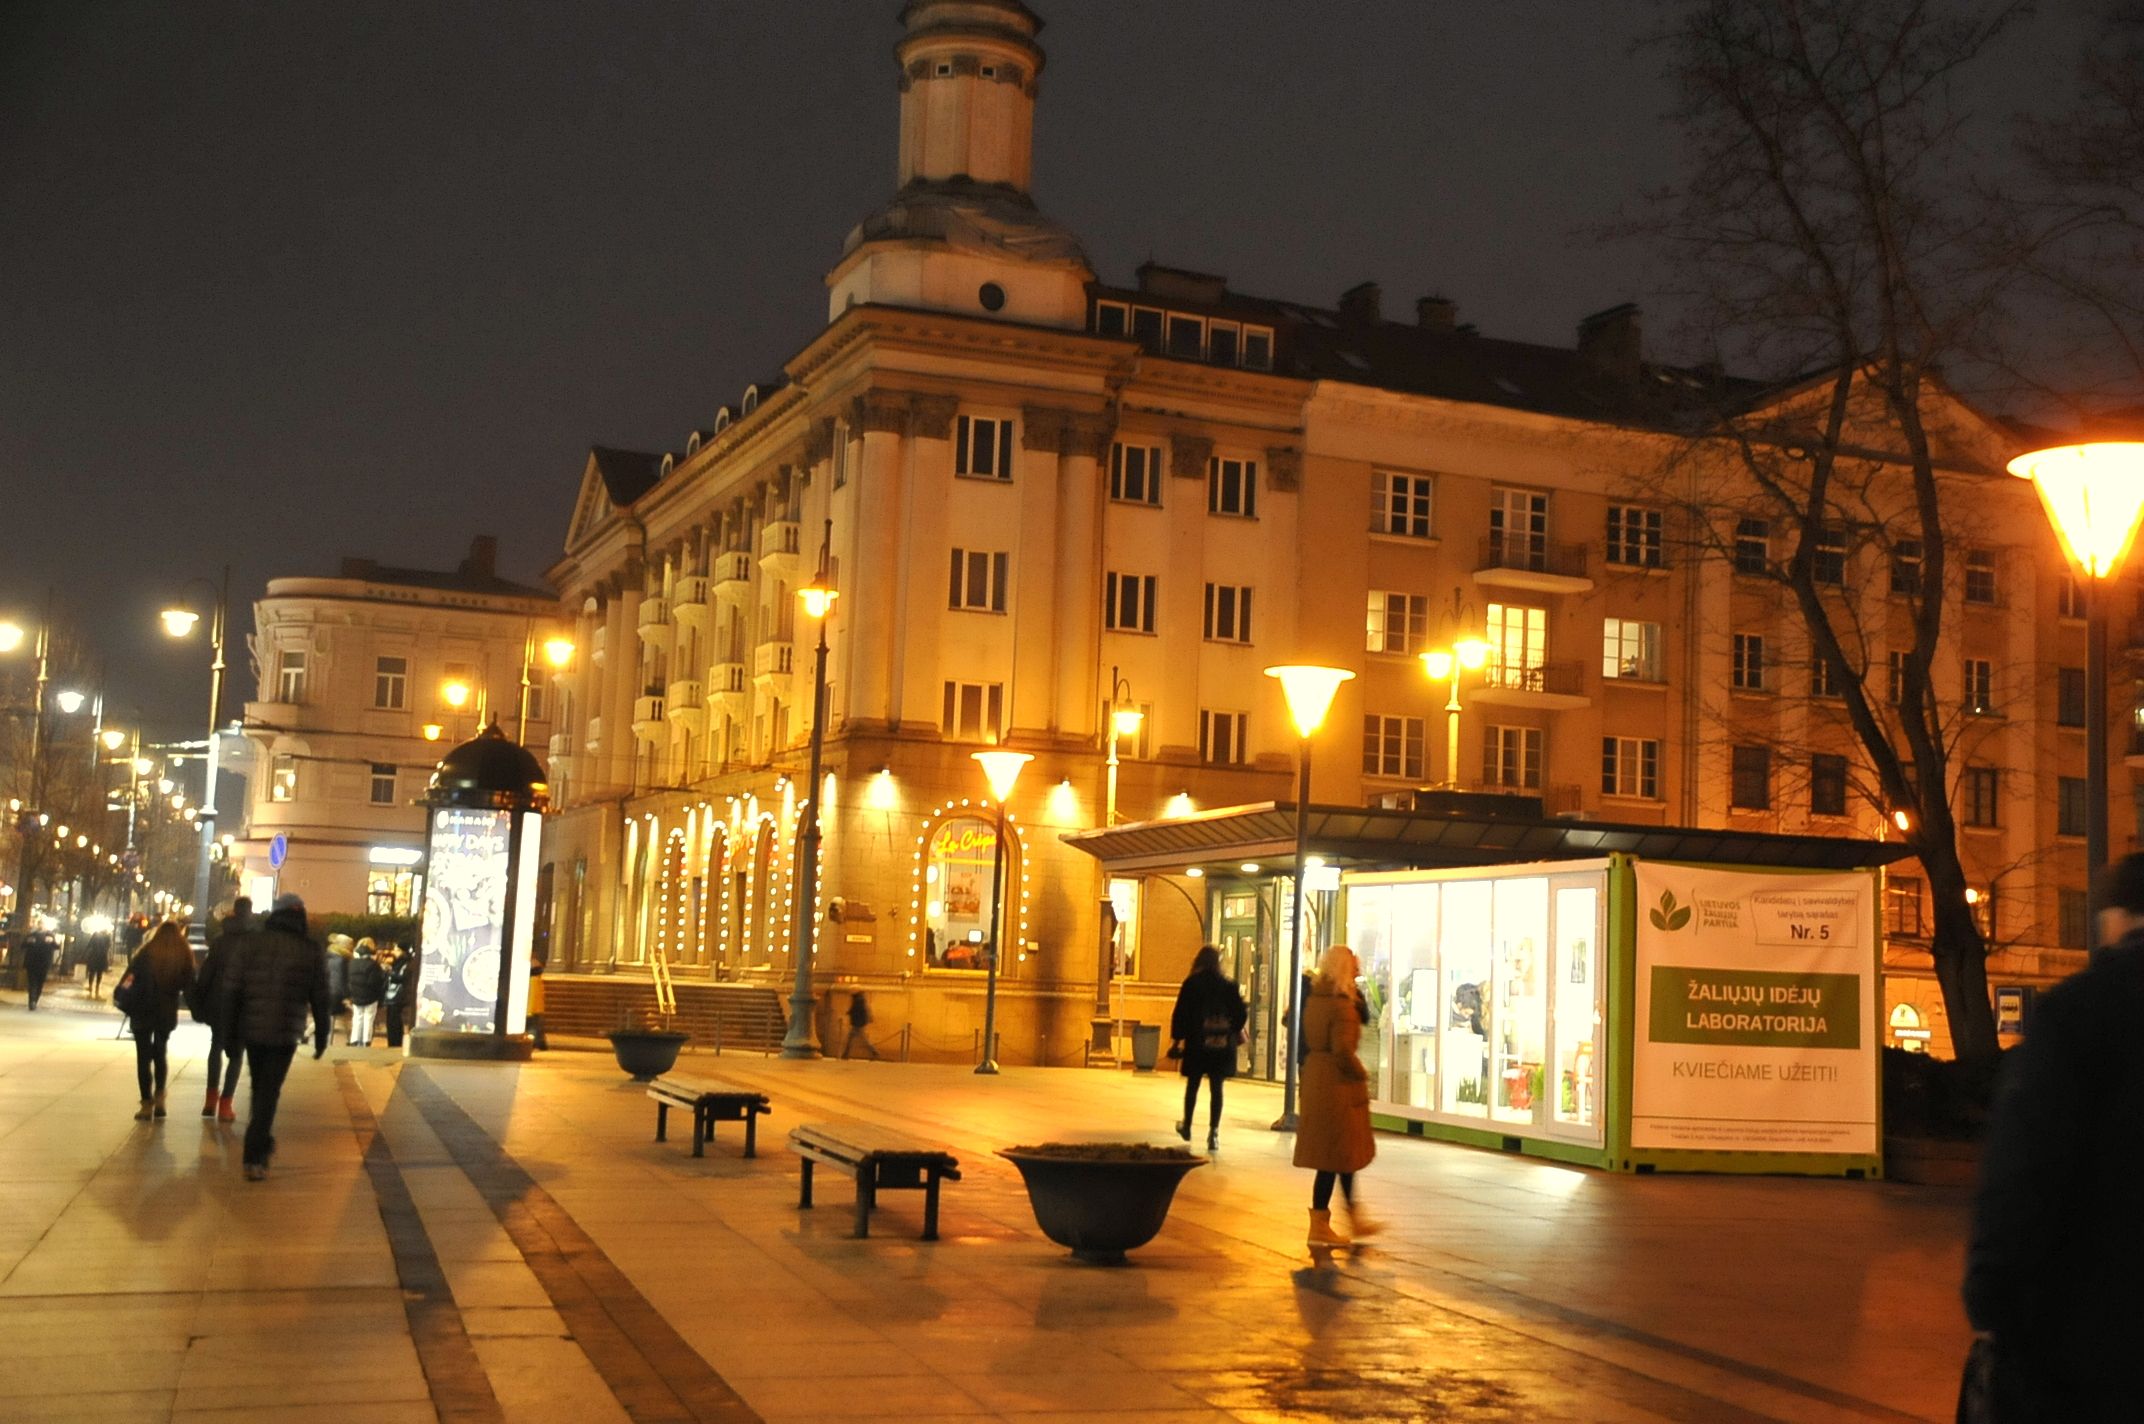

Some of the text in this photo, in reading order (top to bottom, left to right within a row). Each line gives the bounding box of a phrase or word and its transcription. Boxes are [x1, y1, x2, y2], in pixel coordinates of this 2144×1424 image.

[1790, 924, 1830, 940] Nr. 5
[1687, 980, 1822, 1009] ŽALIŲJŲ IDĖJŲ
[1686, 1012, 1828, 1033] LABORATORIJA
[1672, 1060, 1839, 1082] KVIEČIAME UŽEITI!
